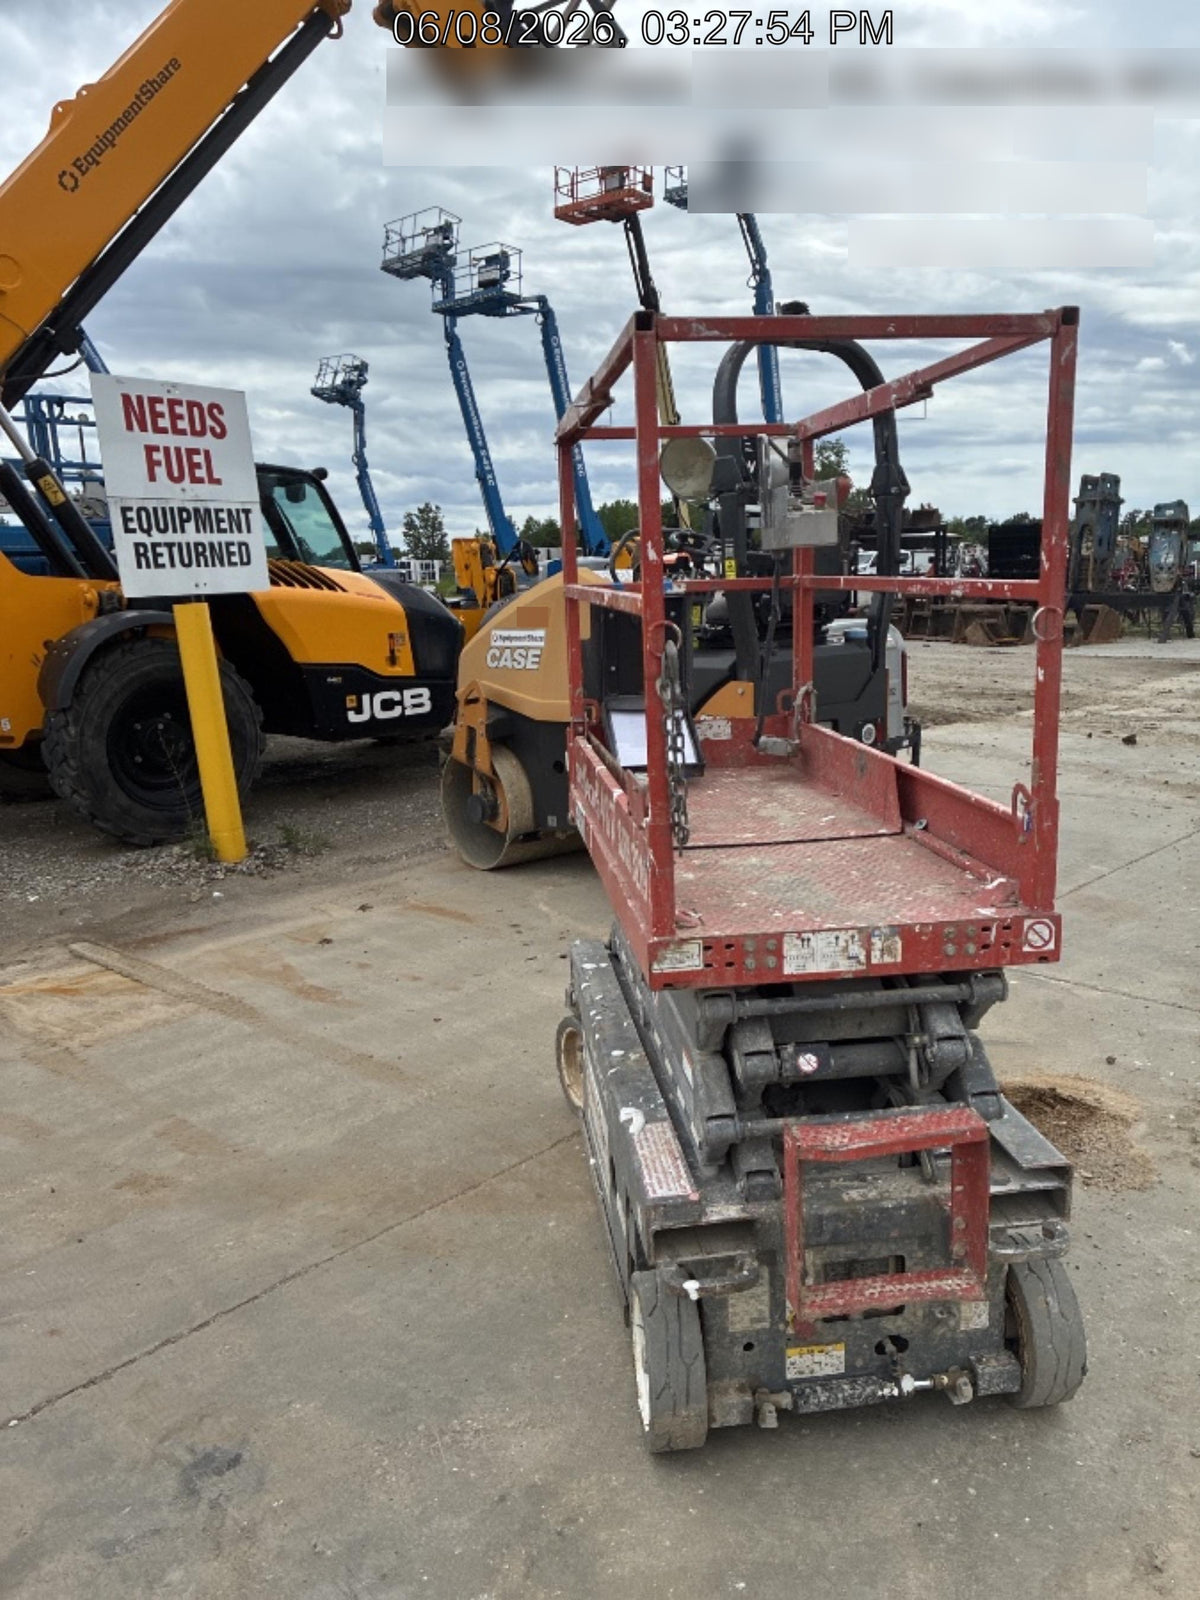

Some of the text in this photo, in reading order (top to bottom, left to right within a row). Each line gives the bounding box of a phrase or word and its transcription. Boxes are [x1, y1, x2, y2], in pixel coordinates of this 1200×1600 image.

[72, 57, 182, 177] EquipmentShare
[121, 393, 228, 440] NEEDS
[144, 444, 223, 485] FUEL
[120, 506, 253, 537] EQUIPMENT
[133, 541, 251, 570] RETURNED
[486, 648, 542, 670] CASE
[347, 687, 432, 723] JCB
